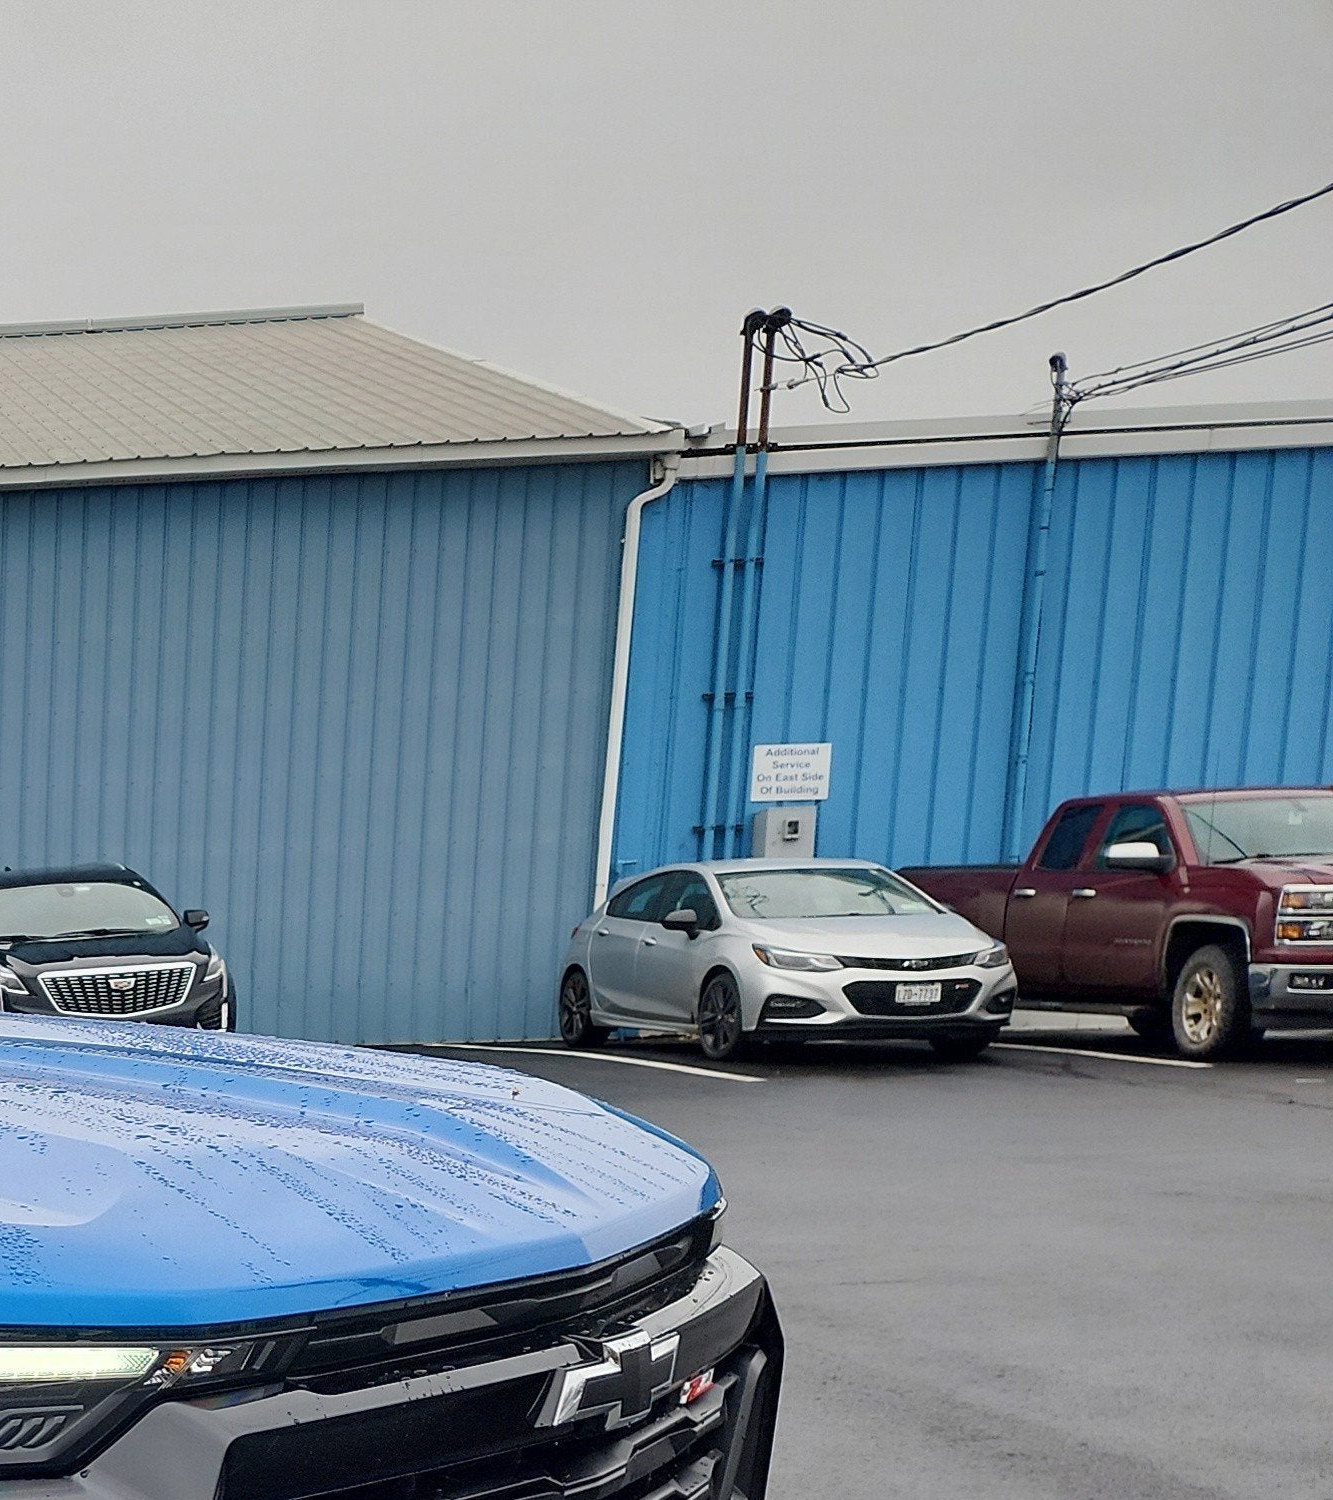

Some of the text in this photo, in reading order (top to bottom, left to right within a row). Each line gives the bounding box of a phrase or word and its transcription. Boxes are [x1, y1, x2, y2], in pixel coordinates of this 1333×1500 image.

[765, 747, 820, 757] Additional
[772, 760, 811, 770] Service
[756, 772, 824, 782] On East Side
[760, 785, 819, 796] Of Building
